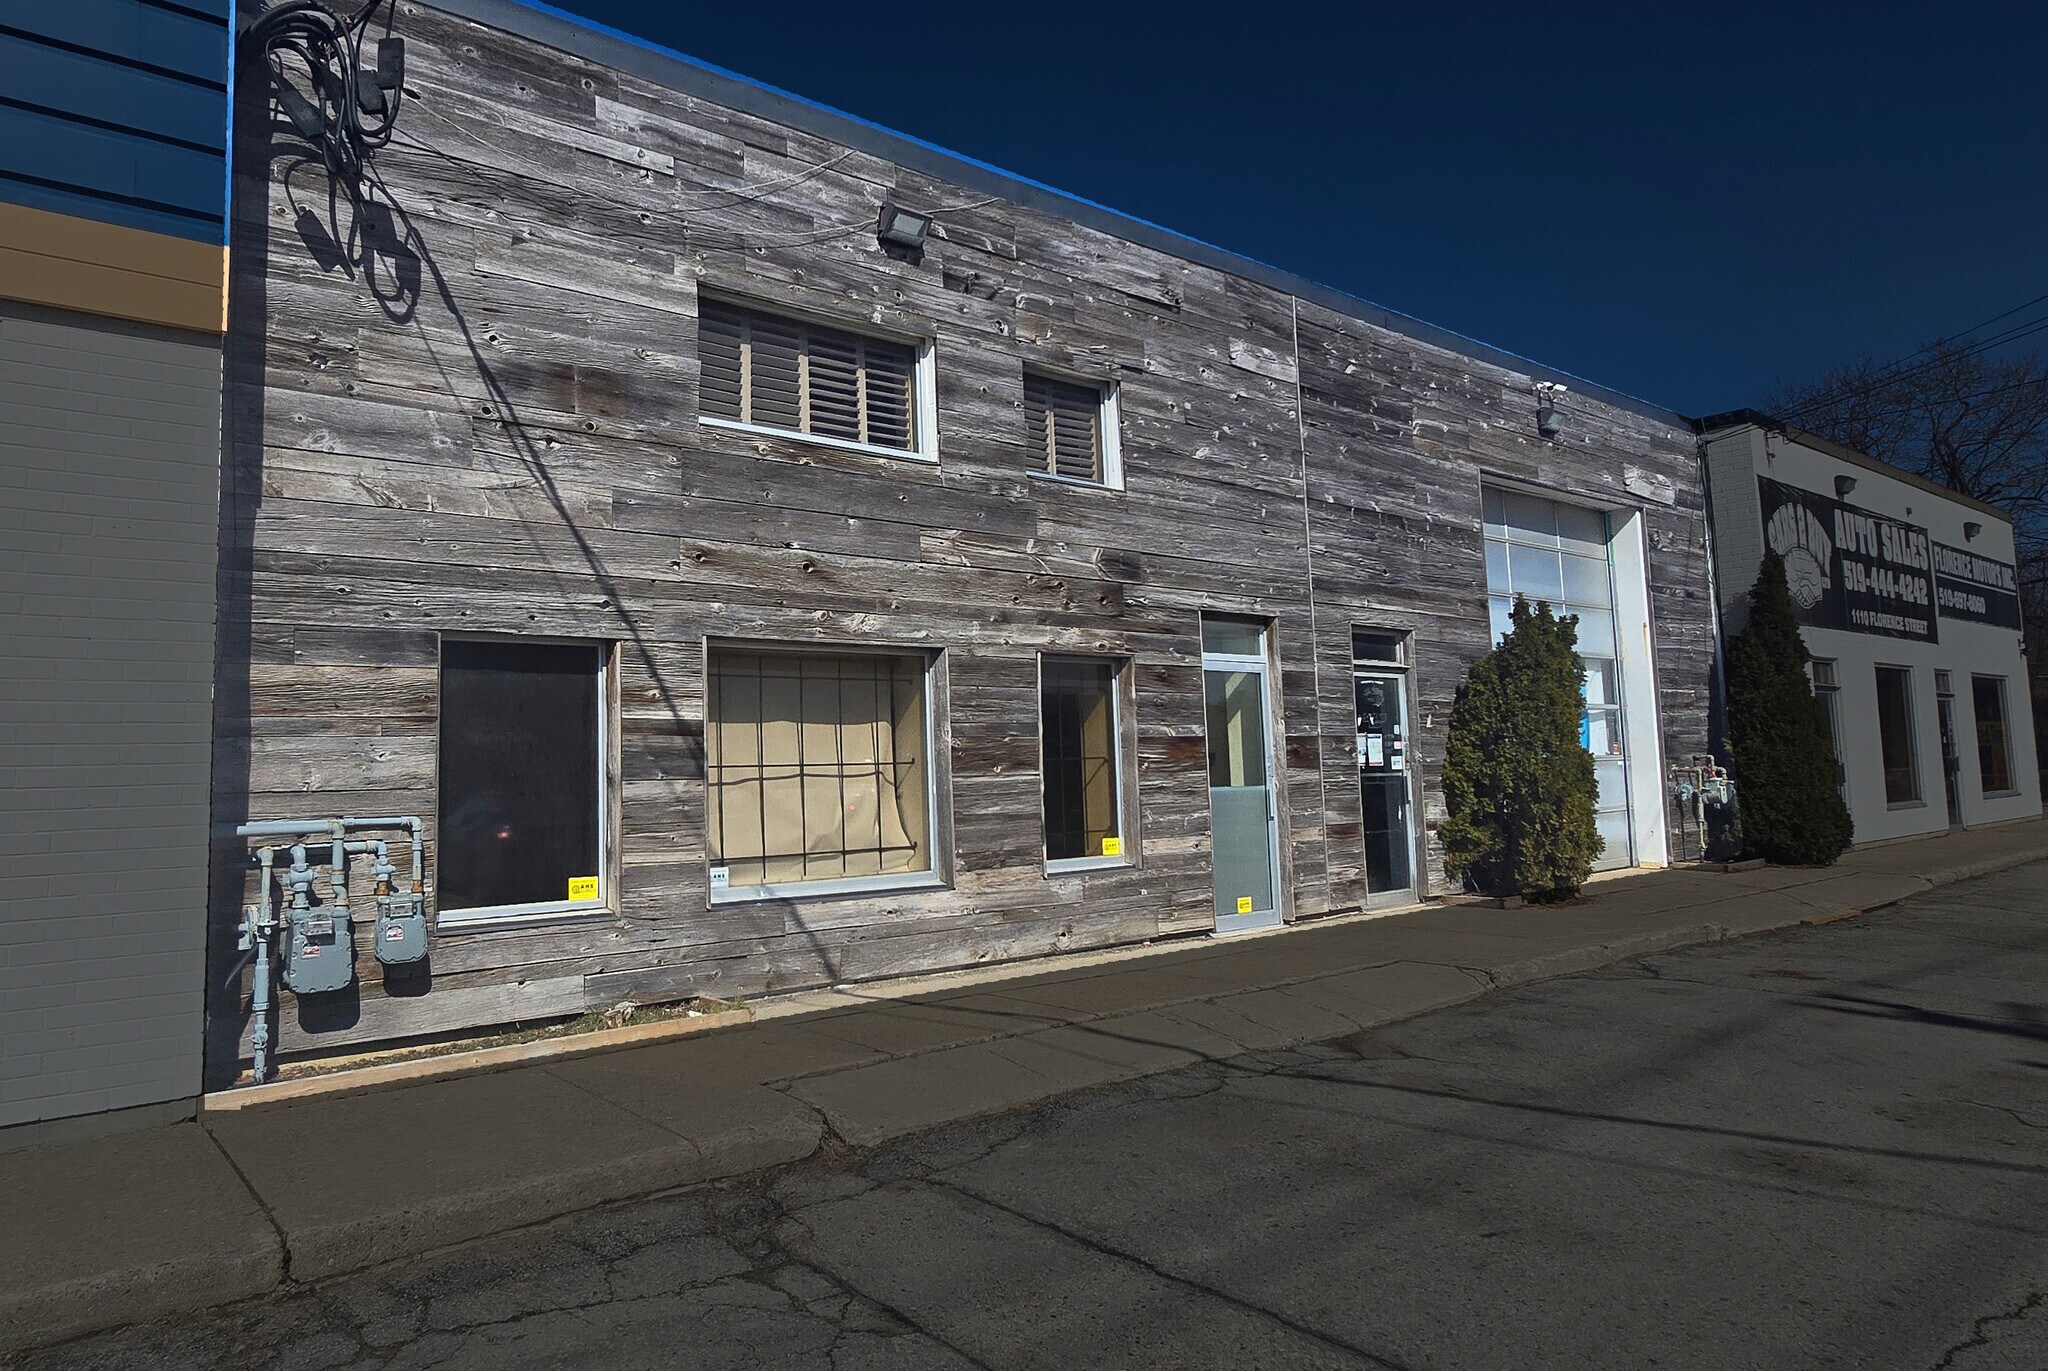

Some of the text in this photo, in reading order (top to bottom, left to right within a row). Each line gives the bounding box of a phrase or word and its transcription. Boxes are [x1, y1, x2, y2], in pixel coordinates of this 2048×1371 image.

[1833, 508, 1929, 571] AUTO SALES
[1842, 559, 1929, 606] 519-444-4242
[1933, 545, 1973, 579] FLORENCE
[1971, 557, 2002, 587] MOTORS
[1851, 608, 1928, 634] 1110 FLORENCE STREET
